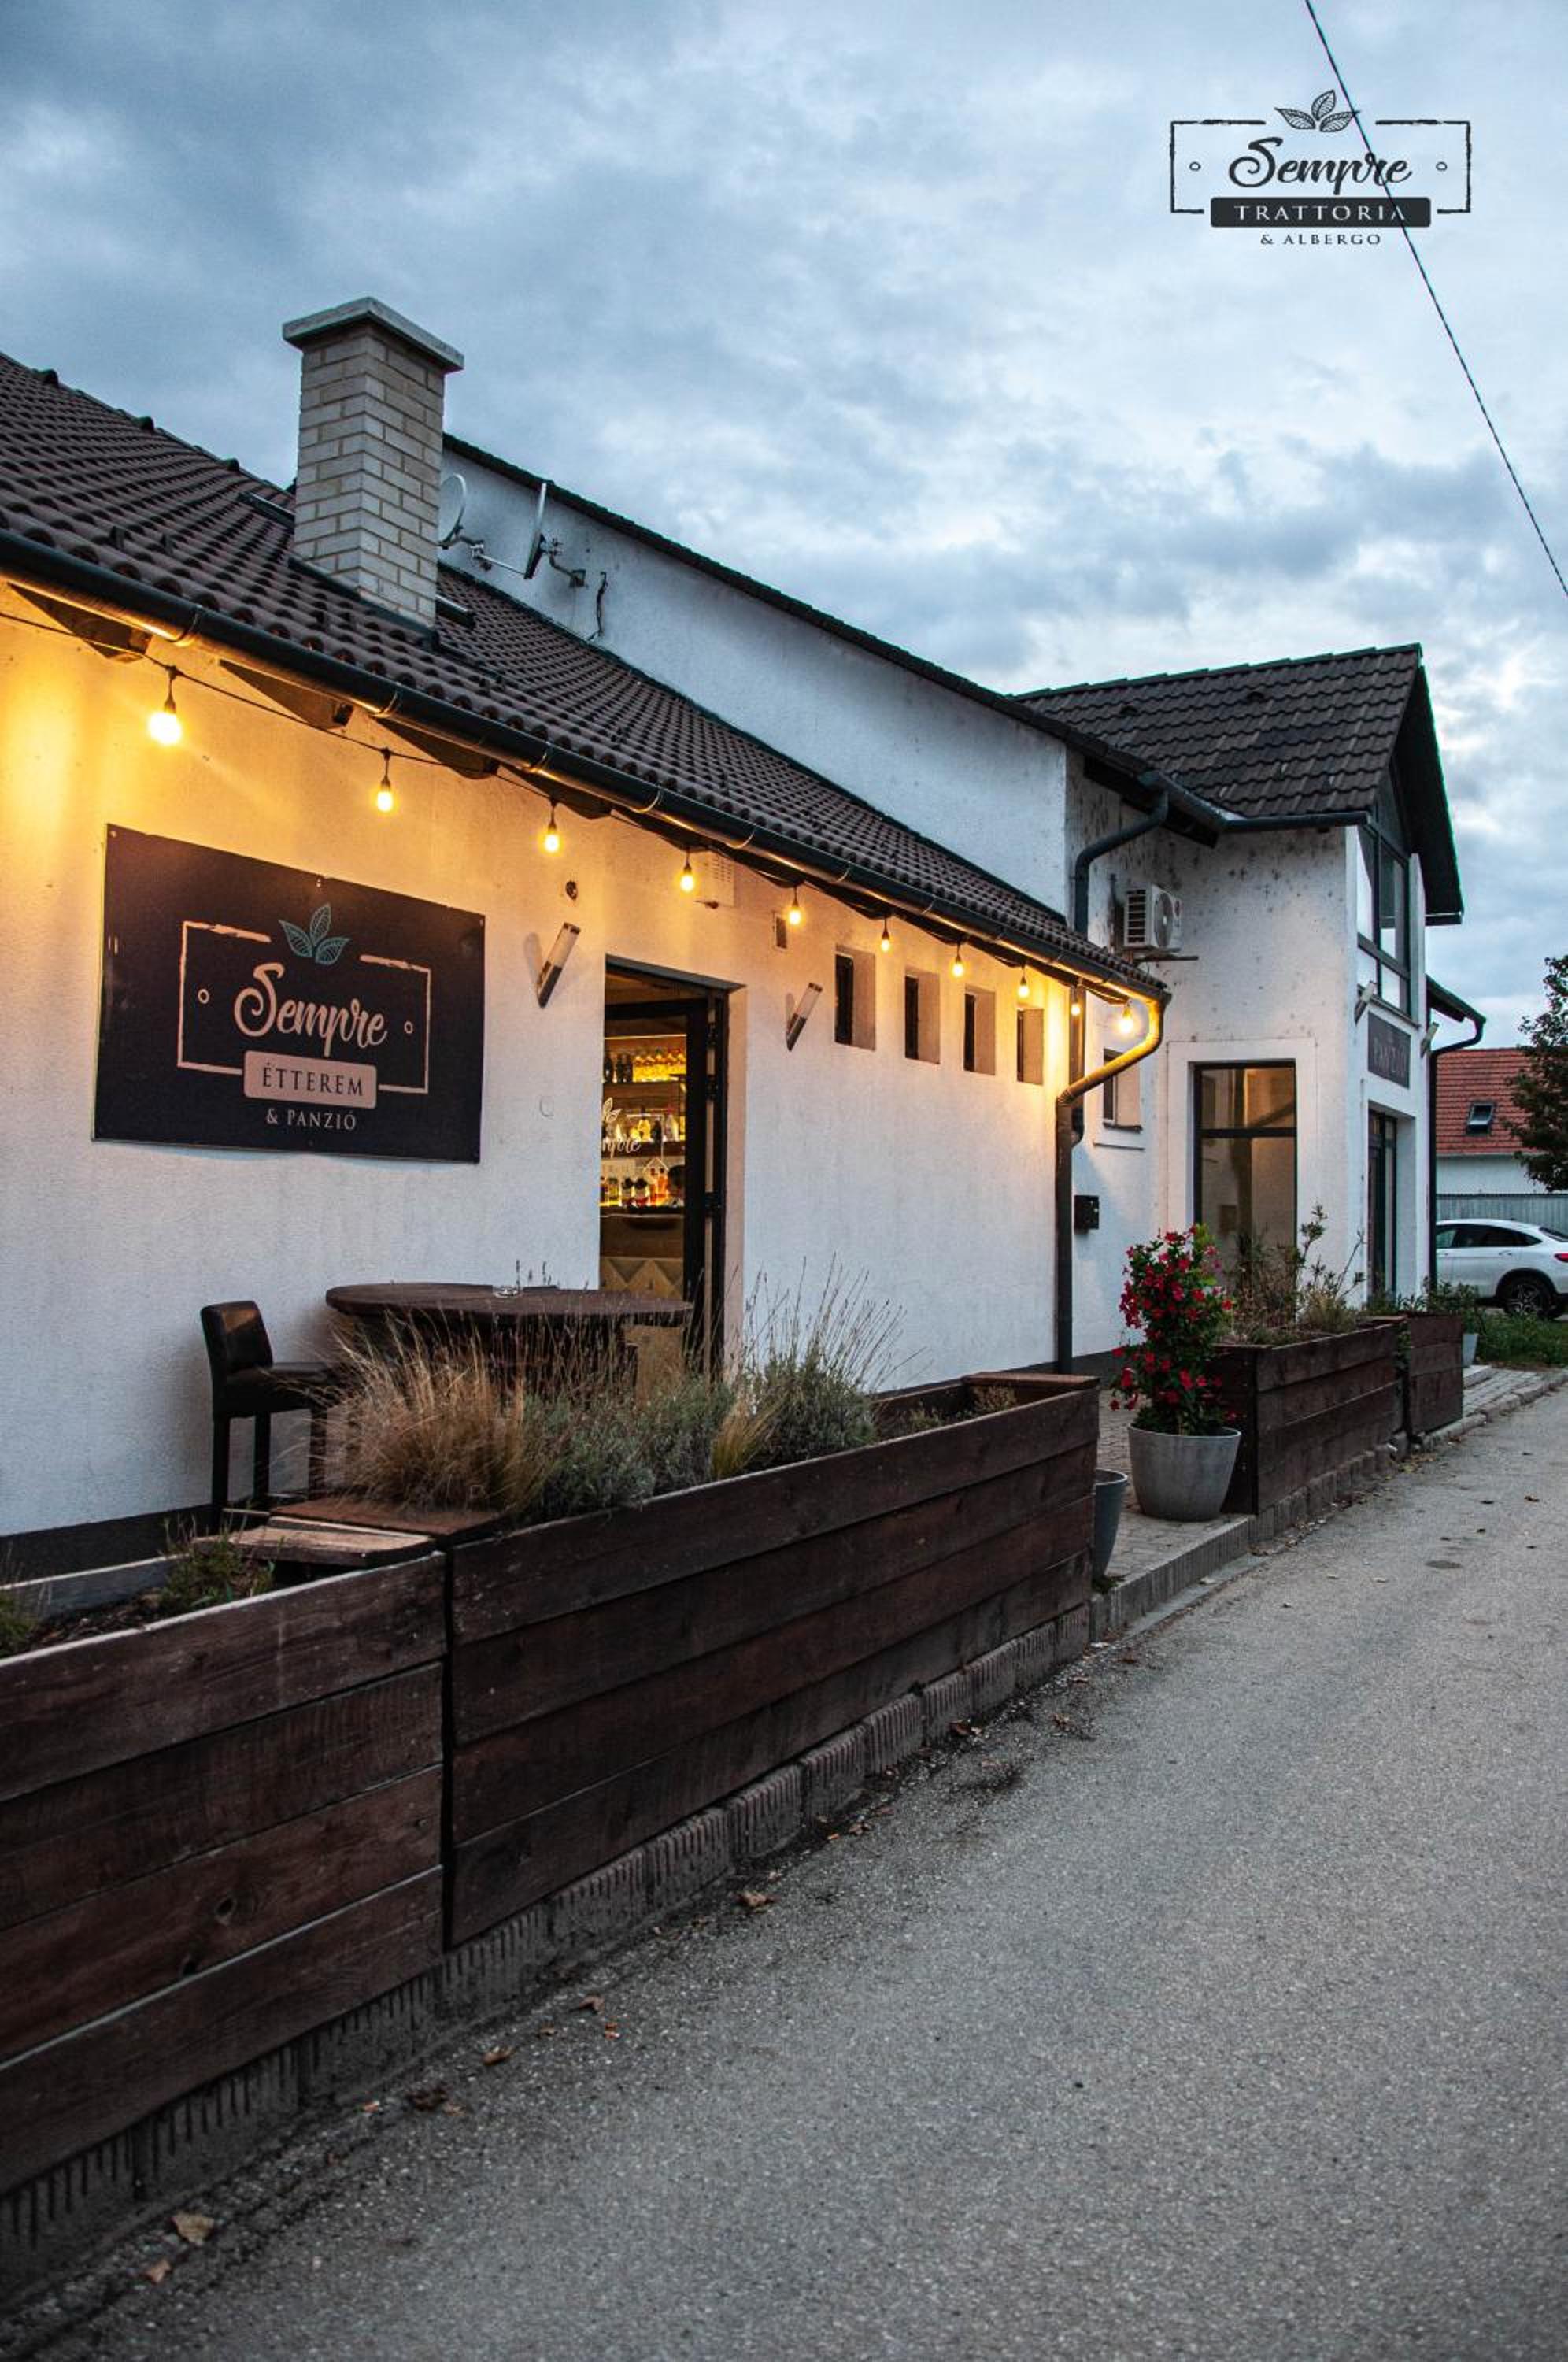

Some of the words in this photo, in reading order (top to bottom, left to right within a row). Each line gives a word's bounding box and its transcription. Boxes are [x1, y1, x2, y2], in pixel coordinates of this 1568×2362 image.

[234, 962, 388, 1057] Sempre
[263, 1062, 364, 1097] ÉTTEREM
[266, 1108, 278, 1125] &
[287, 1109, 357, 1130] PANZIÓ
